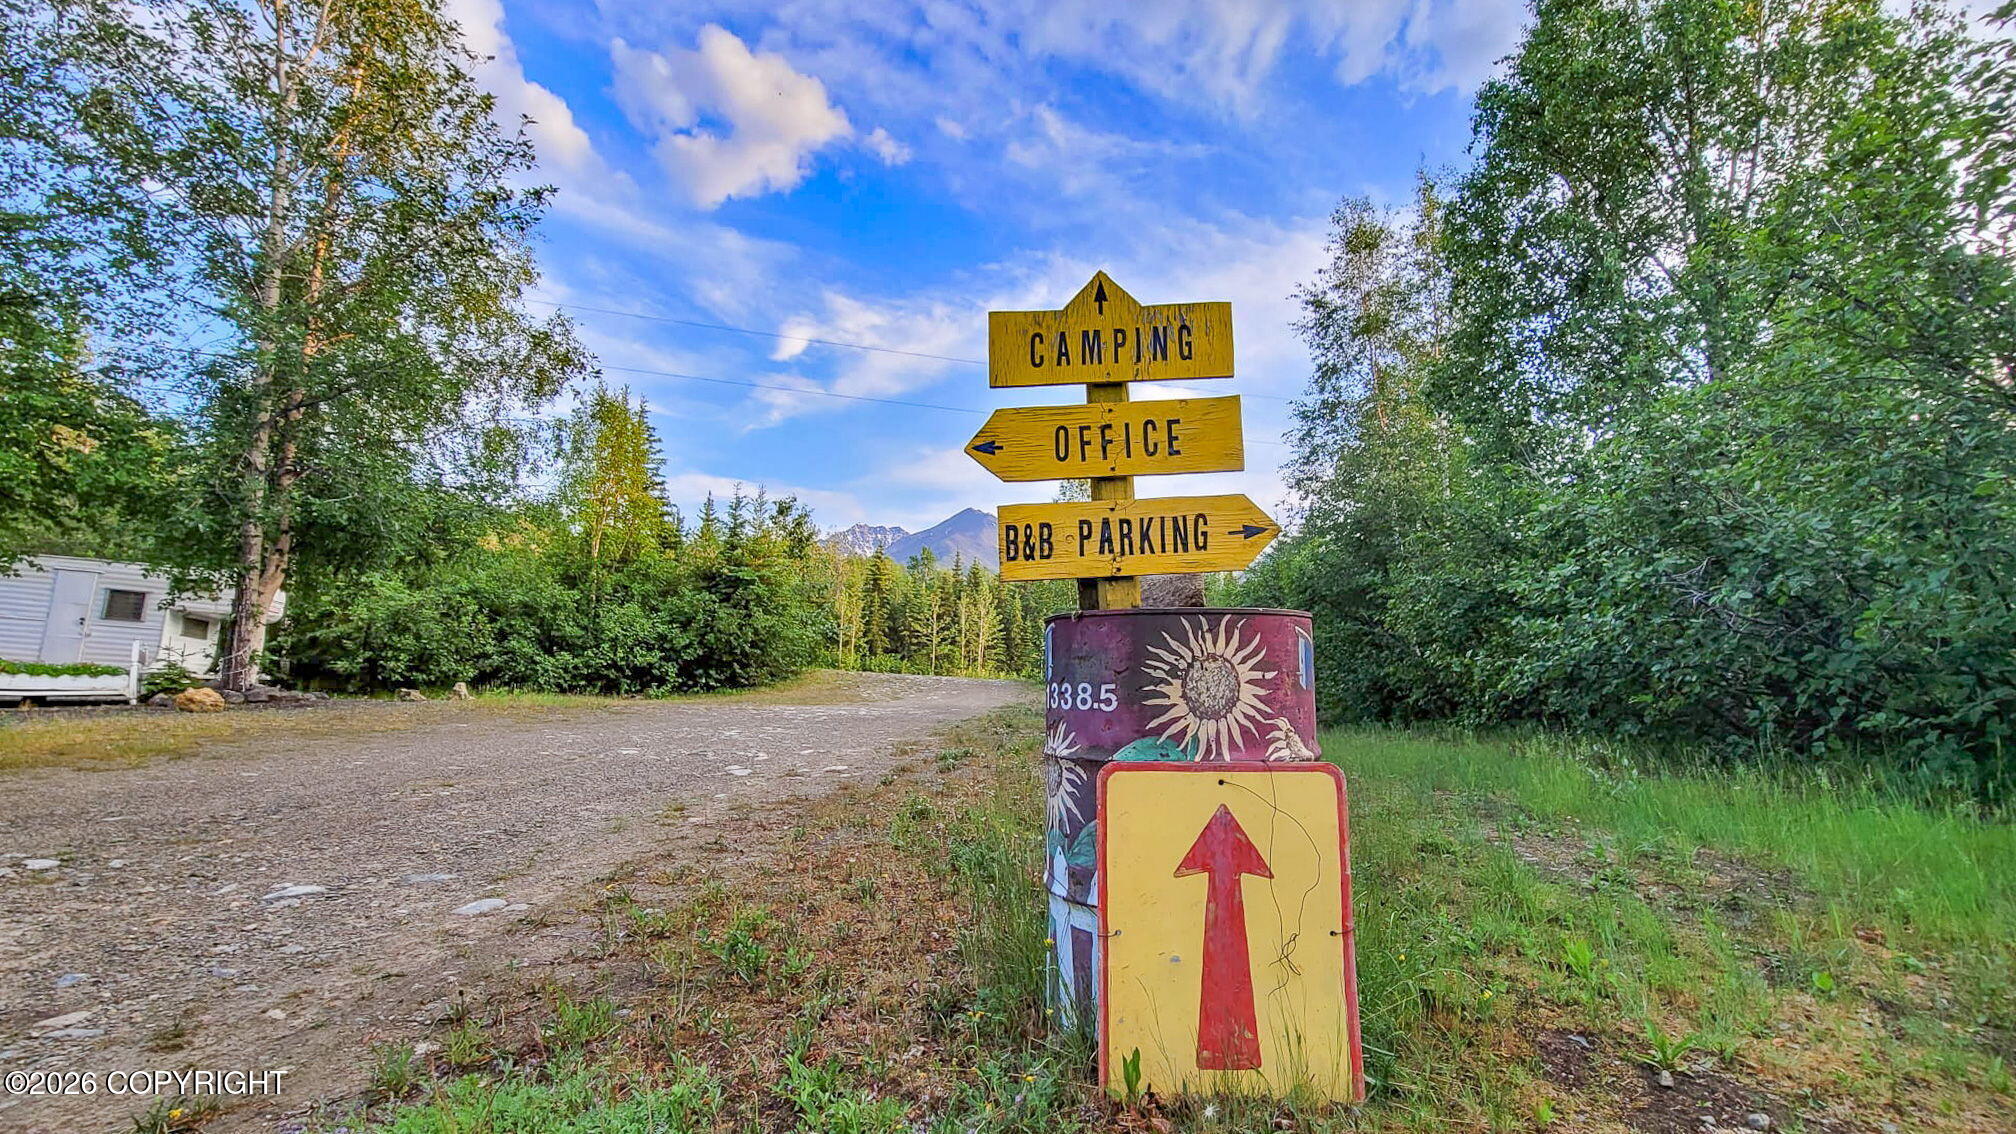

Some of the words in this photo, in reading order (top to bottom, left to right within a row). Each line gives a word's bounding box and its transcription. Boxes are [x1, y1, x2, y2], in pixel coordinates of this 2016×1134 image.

[1030, 324, 1192, 368] CAMPING
[1054, 418, 1182, 462] OFFICE
[1005, 522, 1053, 562] B&B
[1078, 513, 1208, 557] PARKING
